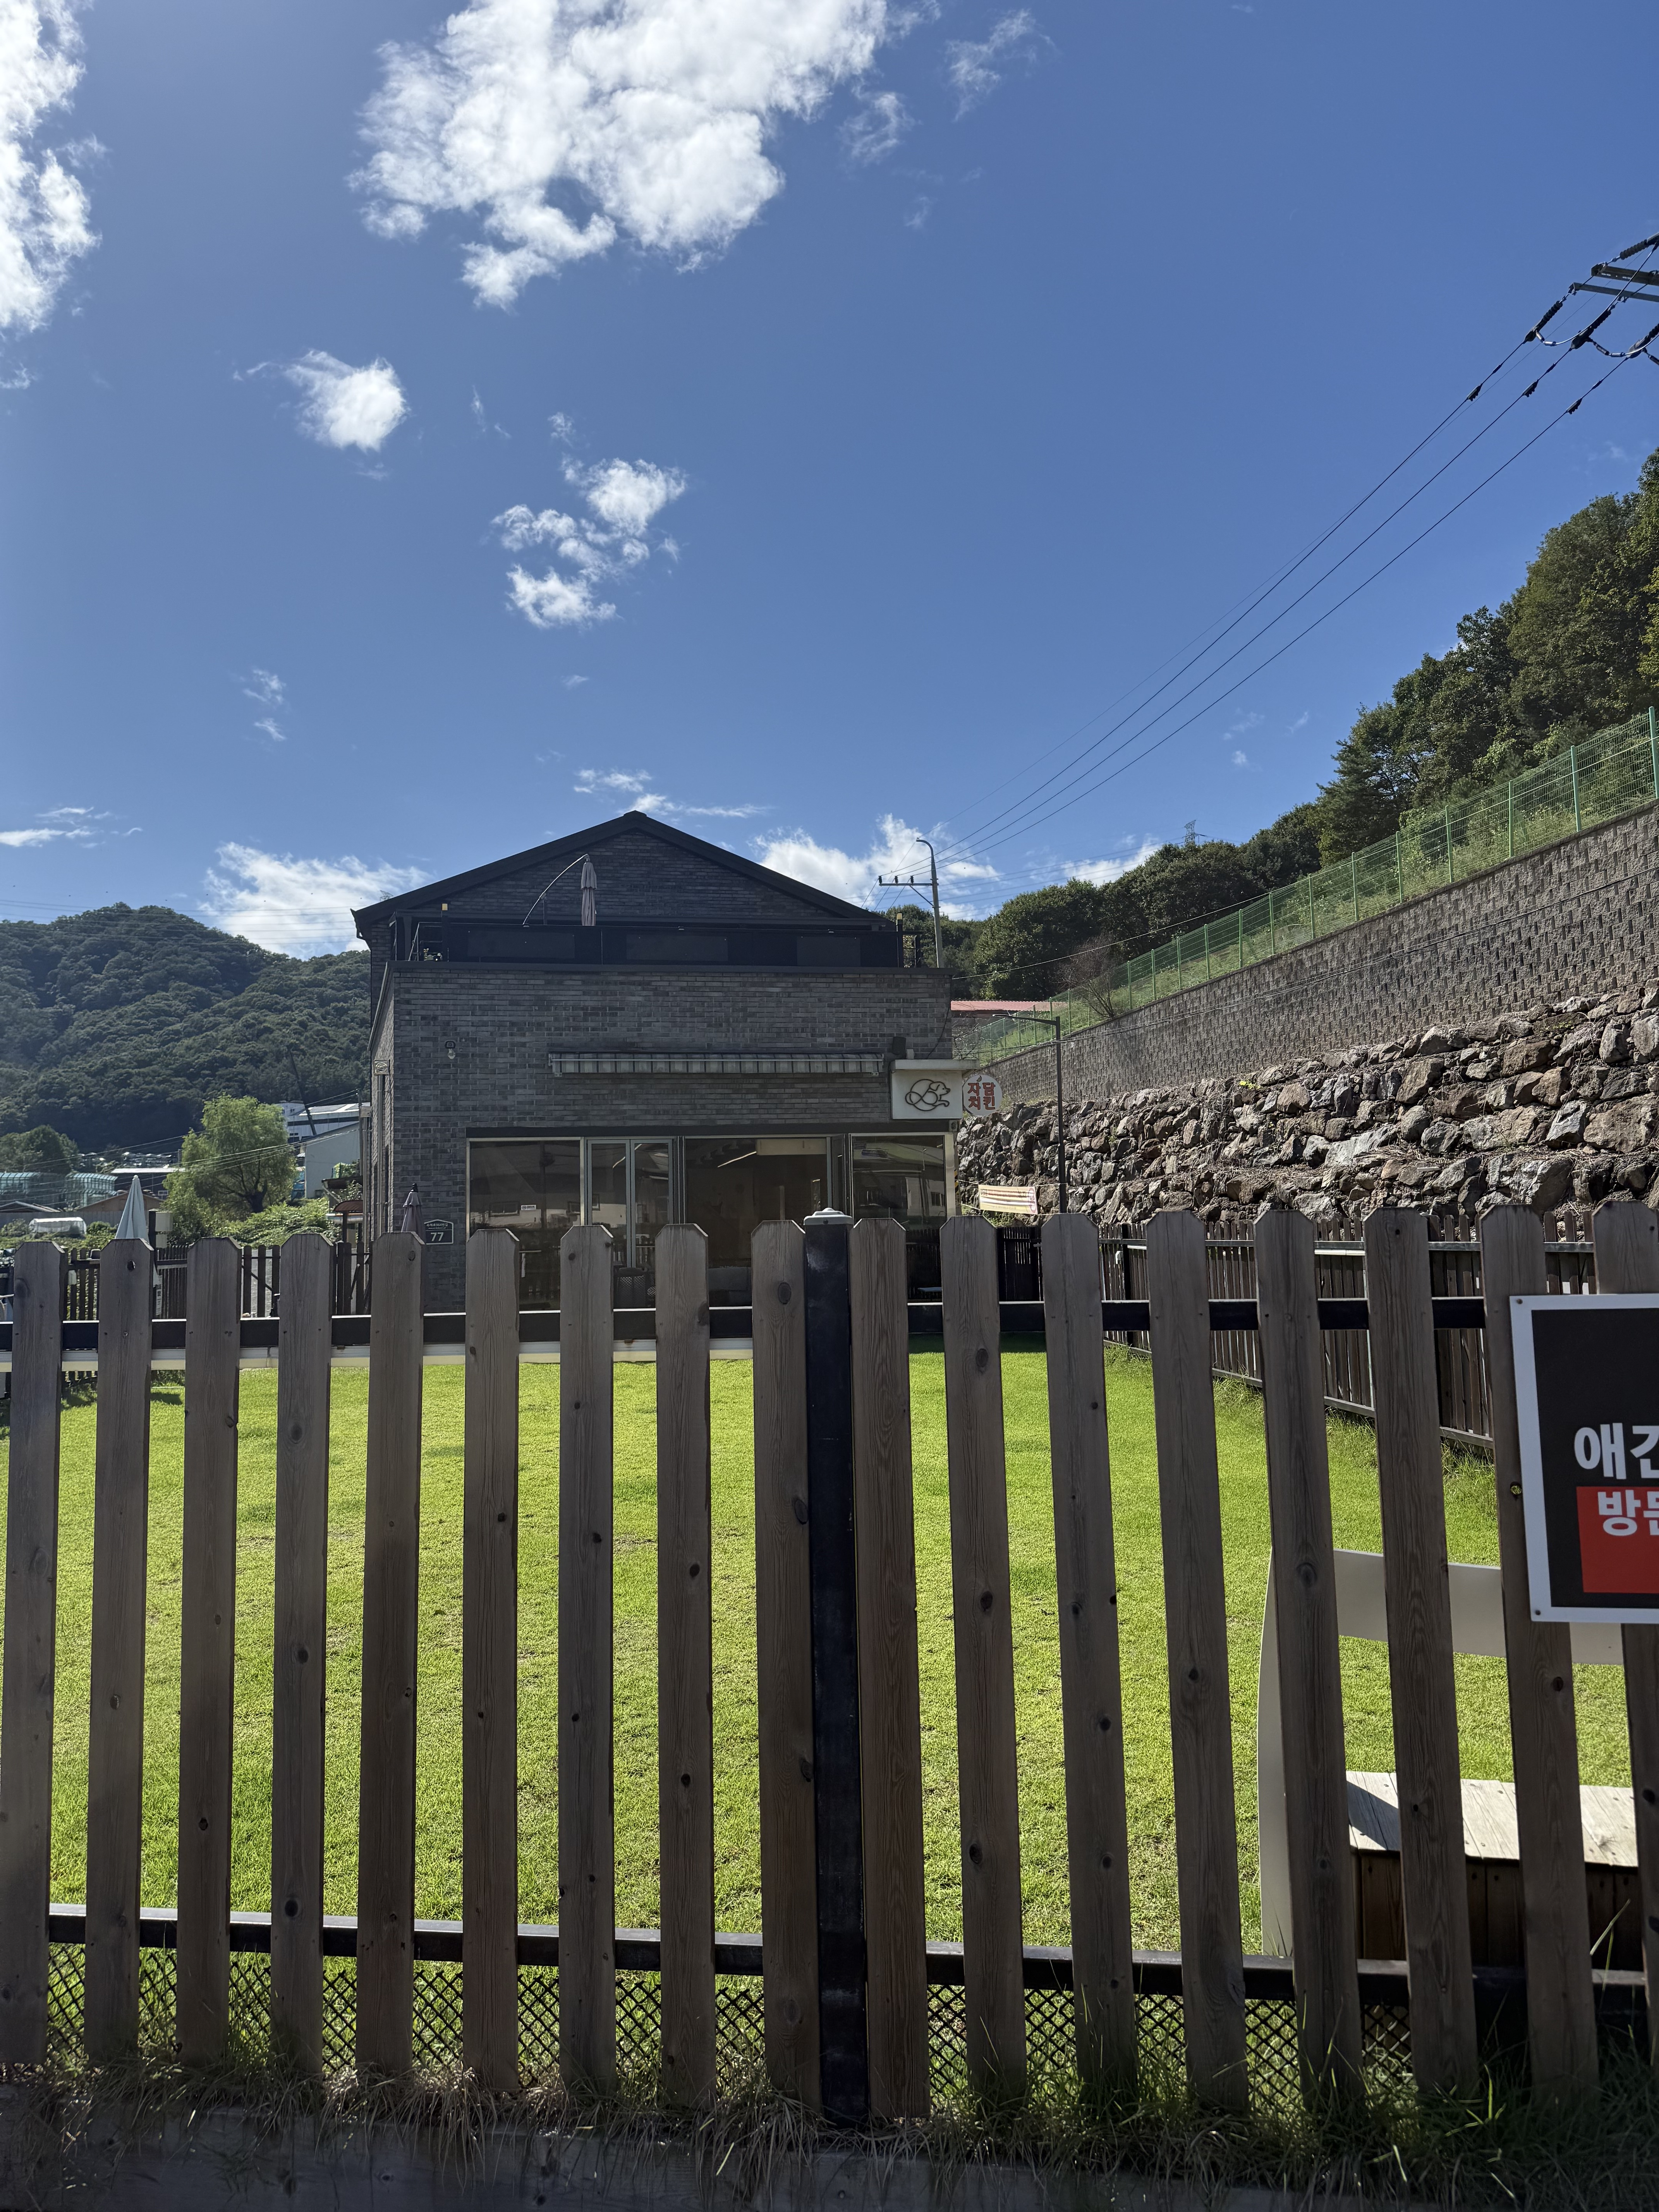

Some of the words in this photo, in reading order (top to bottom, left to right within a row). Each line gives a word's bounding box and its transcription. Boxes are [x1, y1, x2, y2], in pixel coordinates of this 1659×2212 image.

[967, 1082, 996, 1096] 자담
[968, 1096, 996, 1110] 치킨
[430, 1232, 444, 1242] 77
